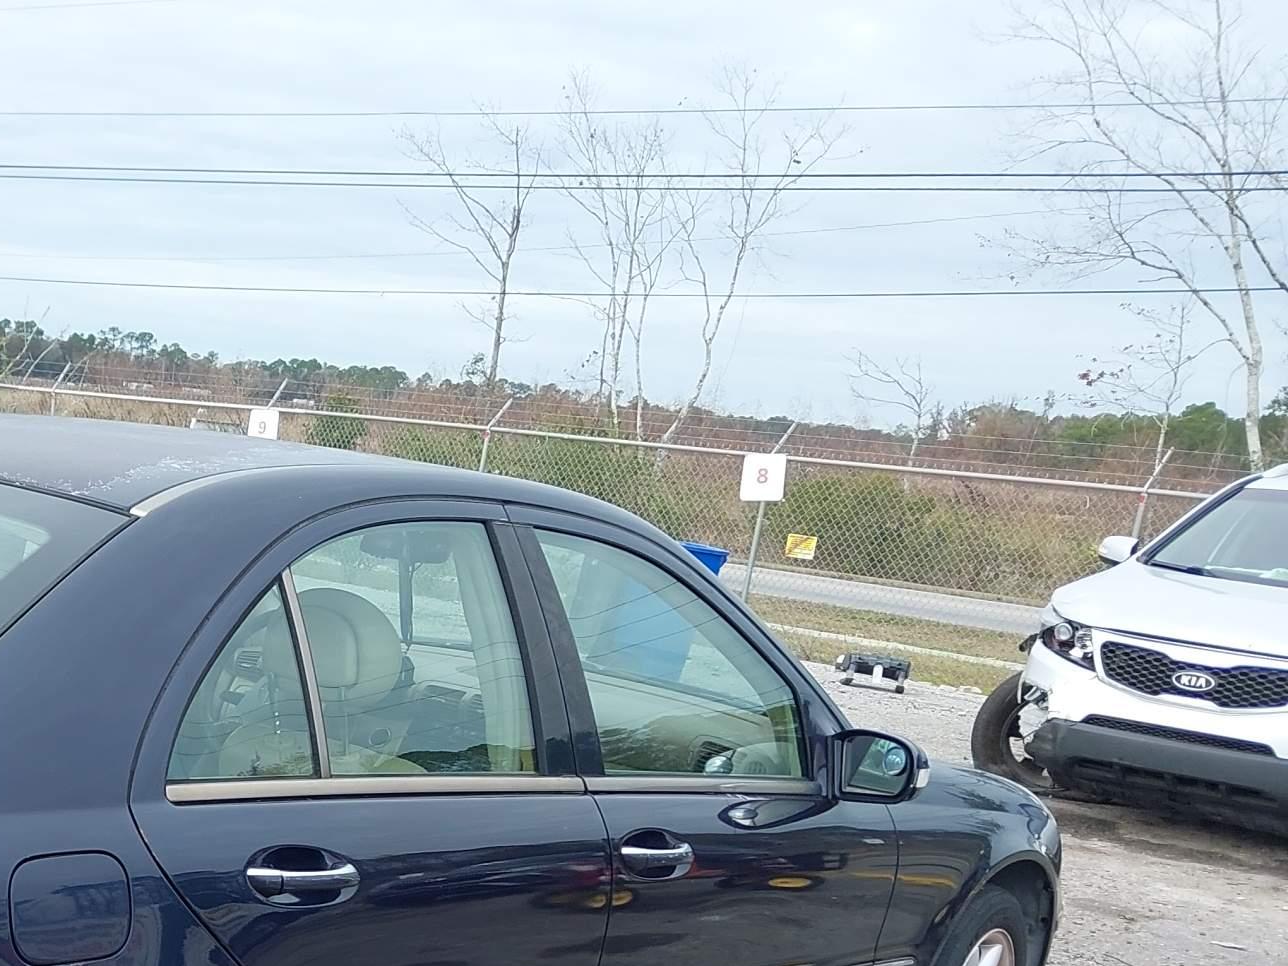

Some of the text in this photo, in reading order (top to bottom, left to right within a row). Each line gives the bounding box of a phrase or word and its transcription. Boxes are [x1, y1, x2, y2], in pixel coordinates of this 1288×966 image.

[258, 420, 267, 434] 9
[756, 467, 769, 485] 8
[1180, 675, 1206, 688] KIA
